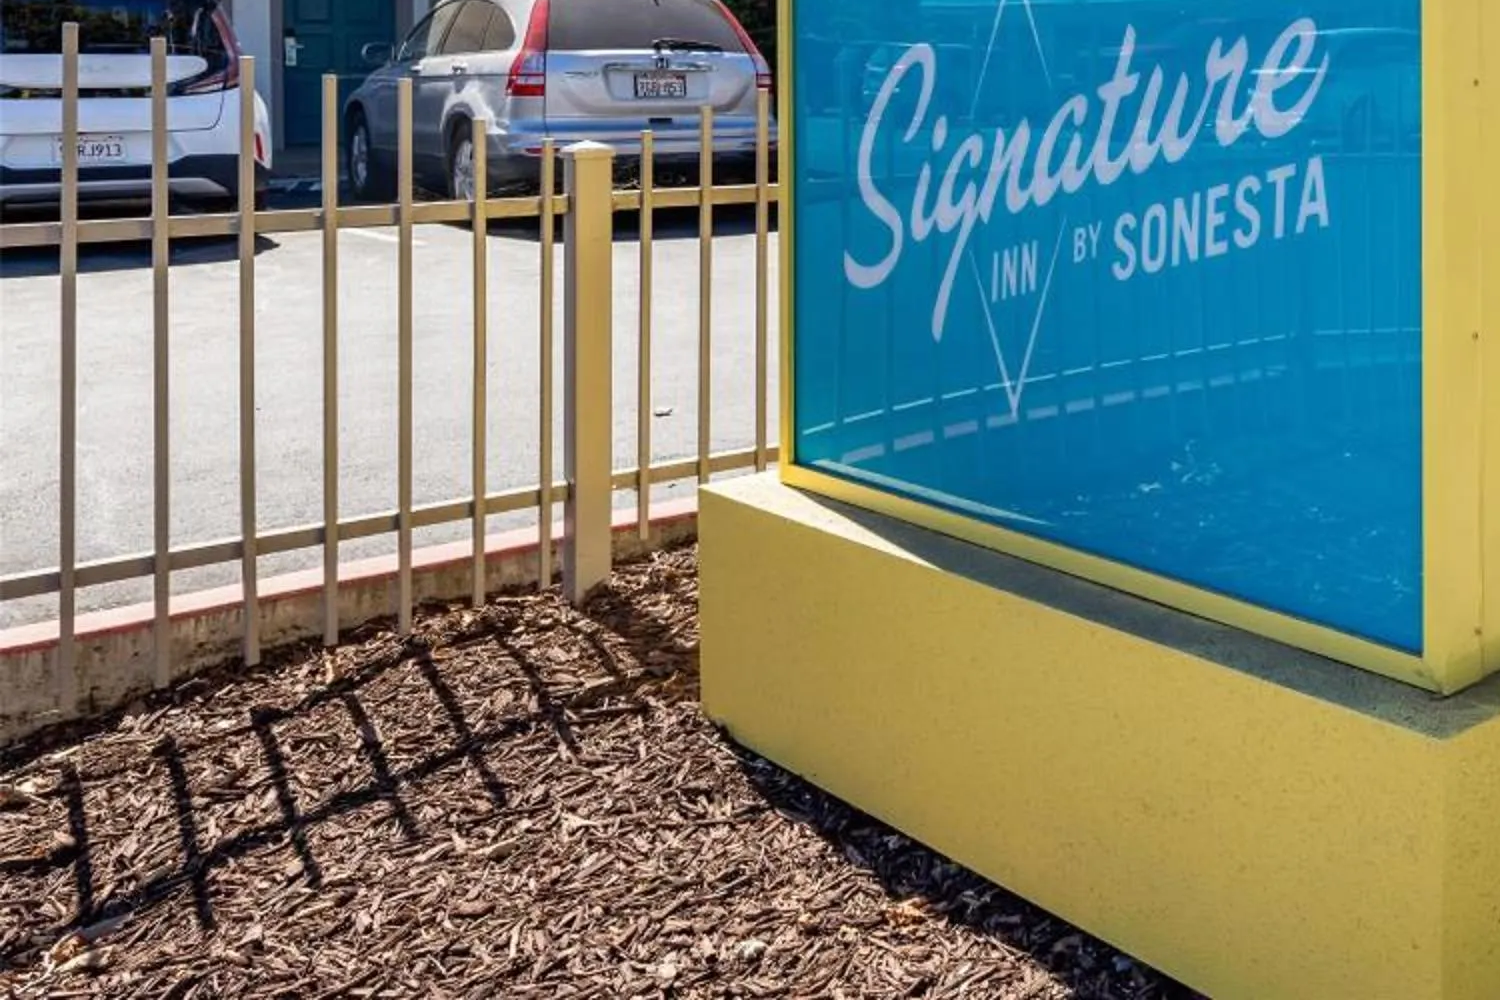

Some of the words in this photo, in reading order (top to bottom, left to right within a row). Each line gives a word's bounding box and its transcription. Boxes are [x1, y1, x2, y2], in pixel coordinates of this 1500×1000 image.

[843, 17, 1330, 344] Signature
[991, 240, 1038, 302] INN
[1072, 221, 1101, 264] BY
[1111, 154, 1330, 281] SONESTA
